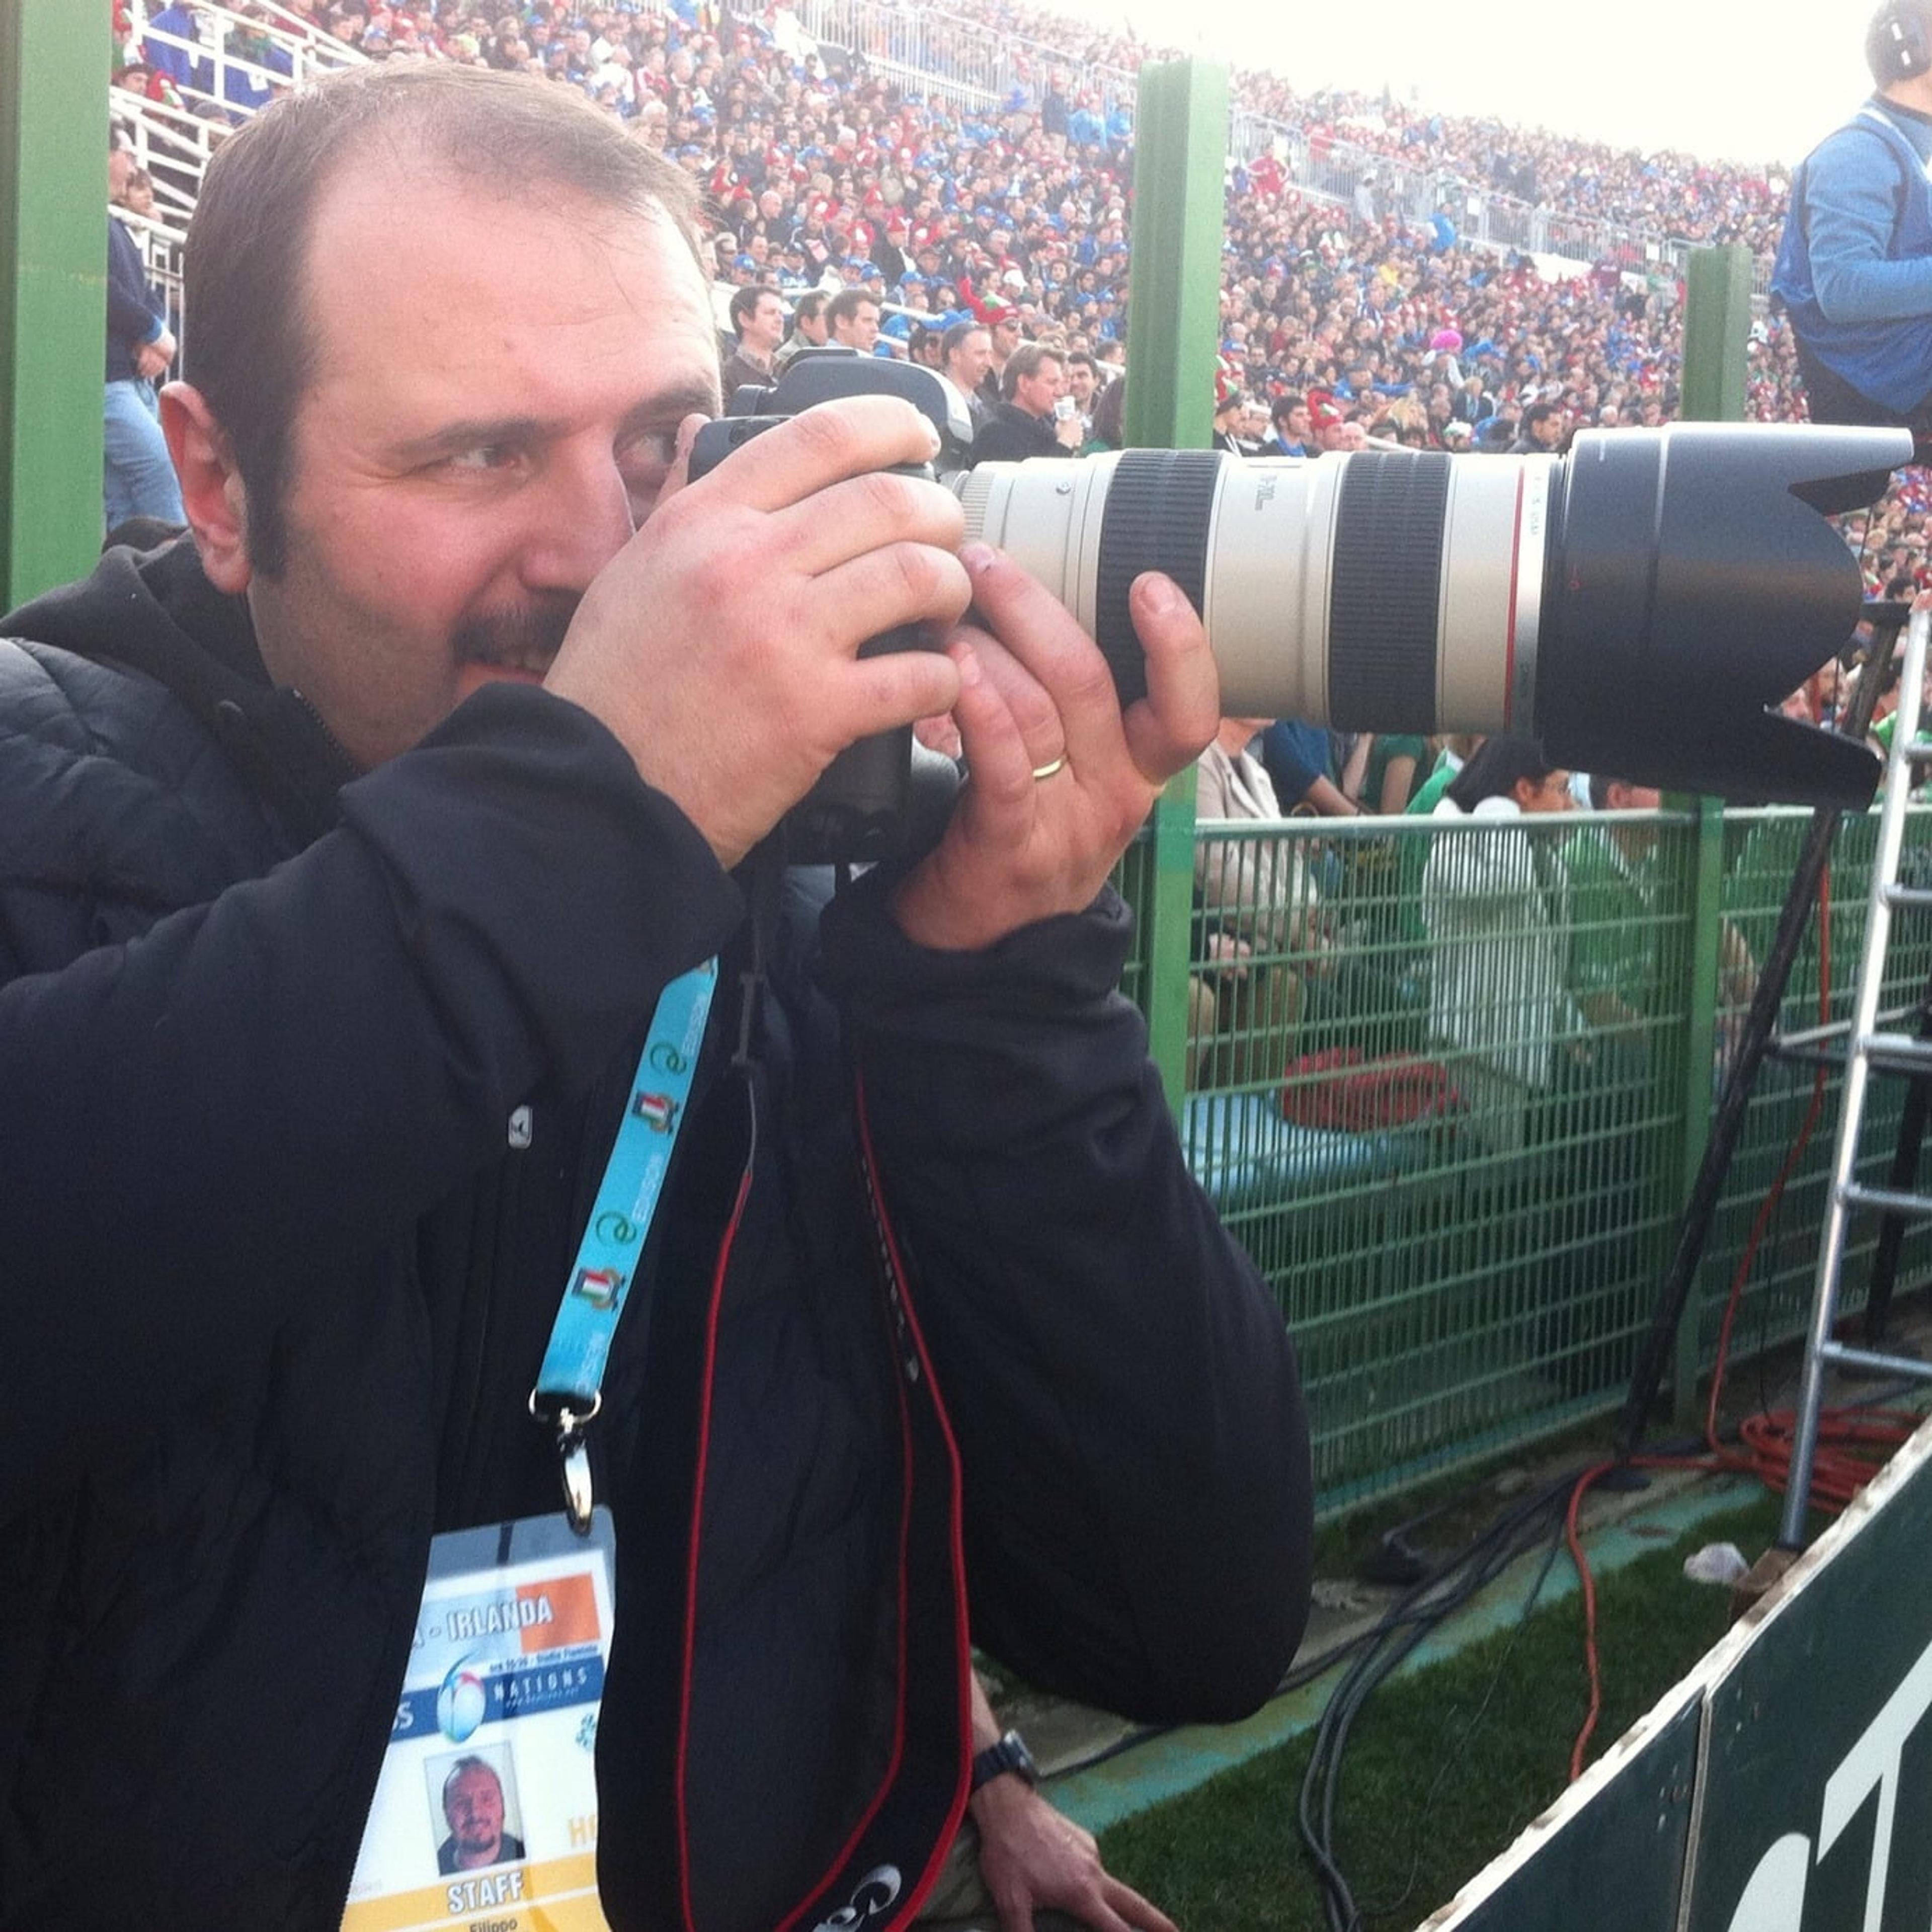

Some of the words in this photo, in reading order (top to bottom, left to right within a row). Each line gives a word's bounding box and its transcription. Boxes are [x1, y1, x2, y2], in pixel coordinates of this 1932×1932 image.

[446, 1592, 552, 1641] IRLANDA
[494, 1666, 587, 1702] NATIONS
[447, 1870, 523, 1914] STAFF
